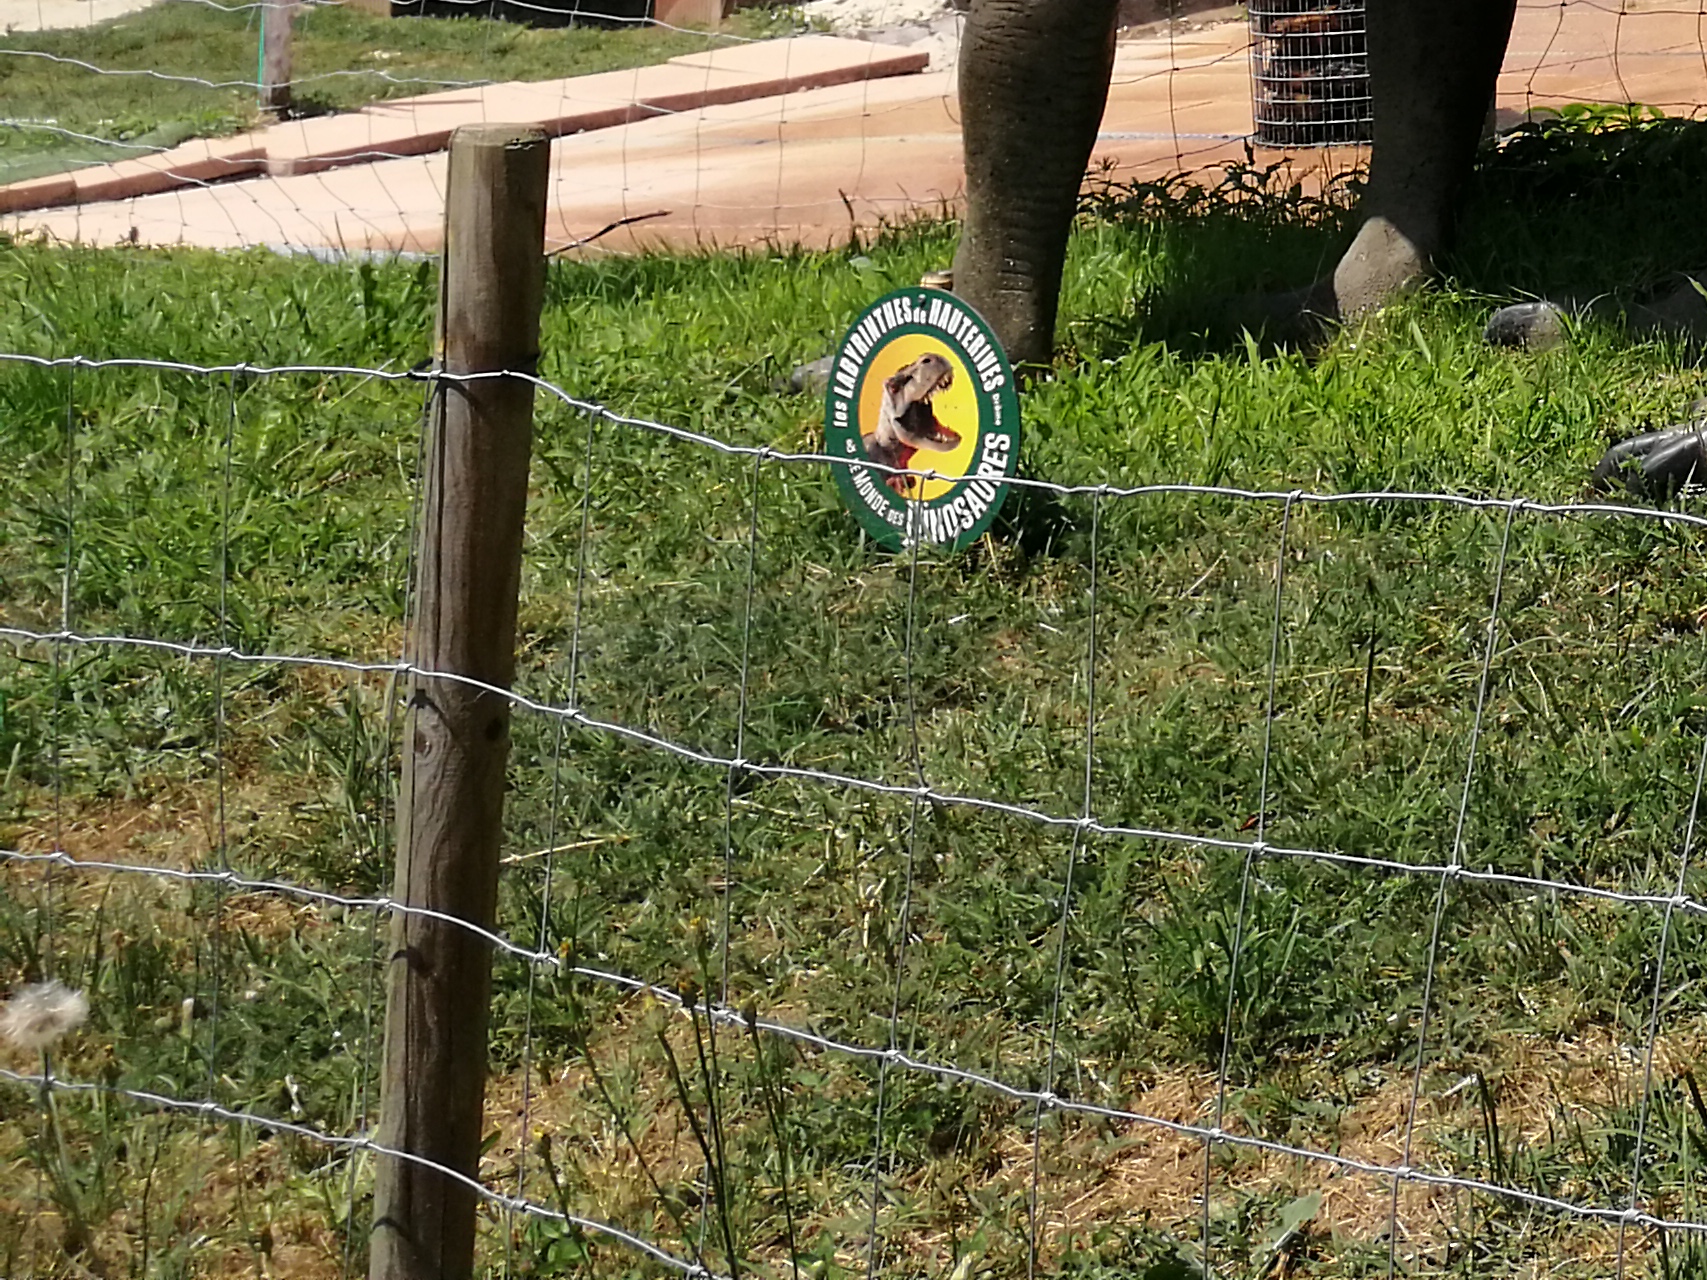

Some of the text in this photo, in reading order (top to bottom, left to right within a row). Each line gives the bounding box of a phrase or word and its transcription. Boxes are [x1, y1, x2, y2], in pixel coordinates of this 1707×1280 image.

[833, 296, 913, 400] LABYRINTHES
[913, 307, 927, 325] de
[928, 297, 1006, 393] HAUTERIVES
[853, 469, 891, 517] MONDE
[887, 509, 905, 527] DES
